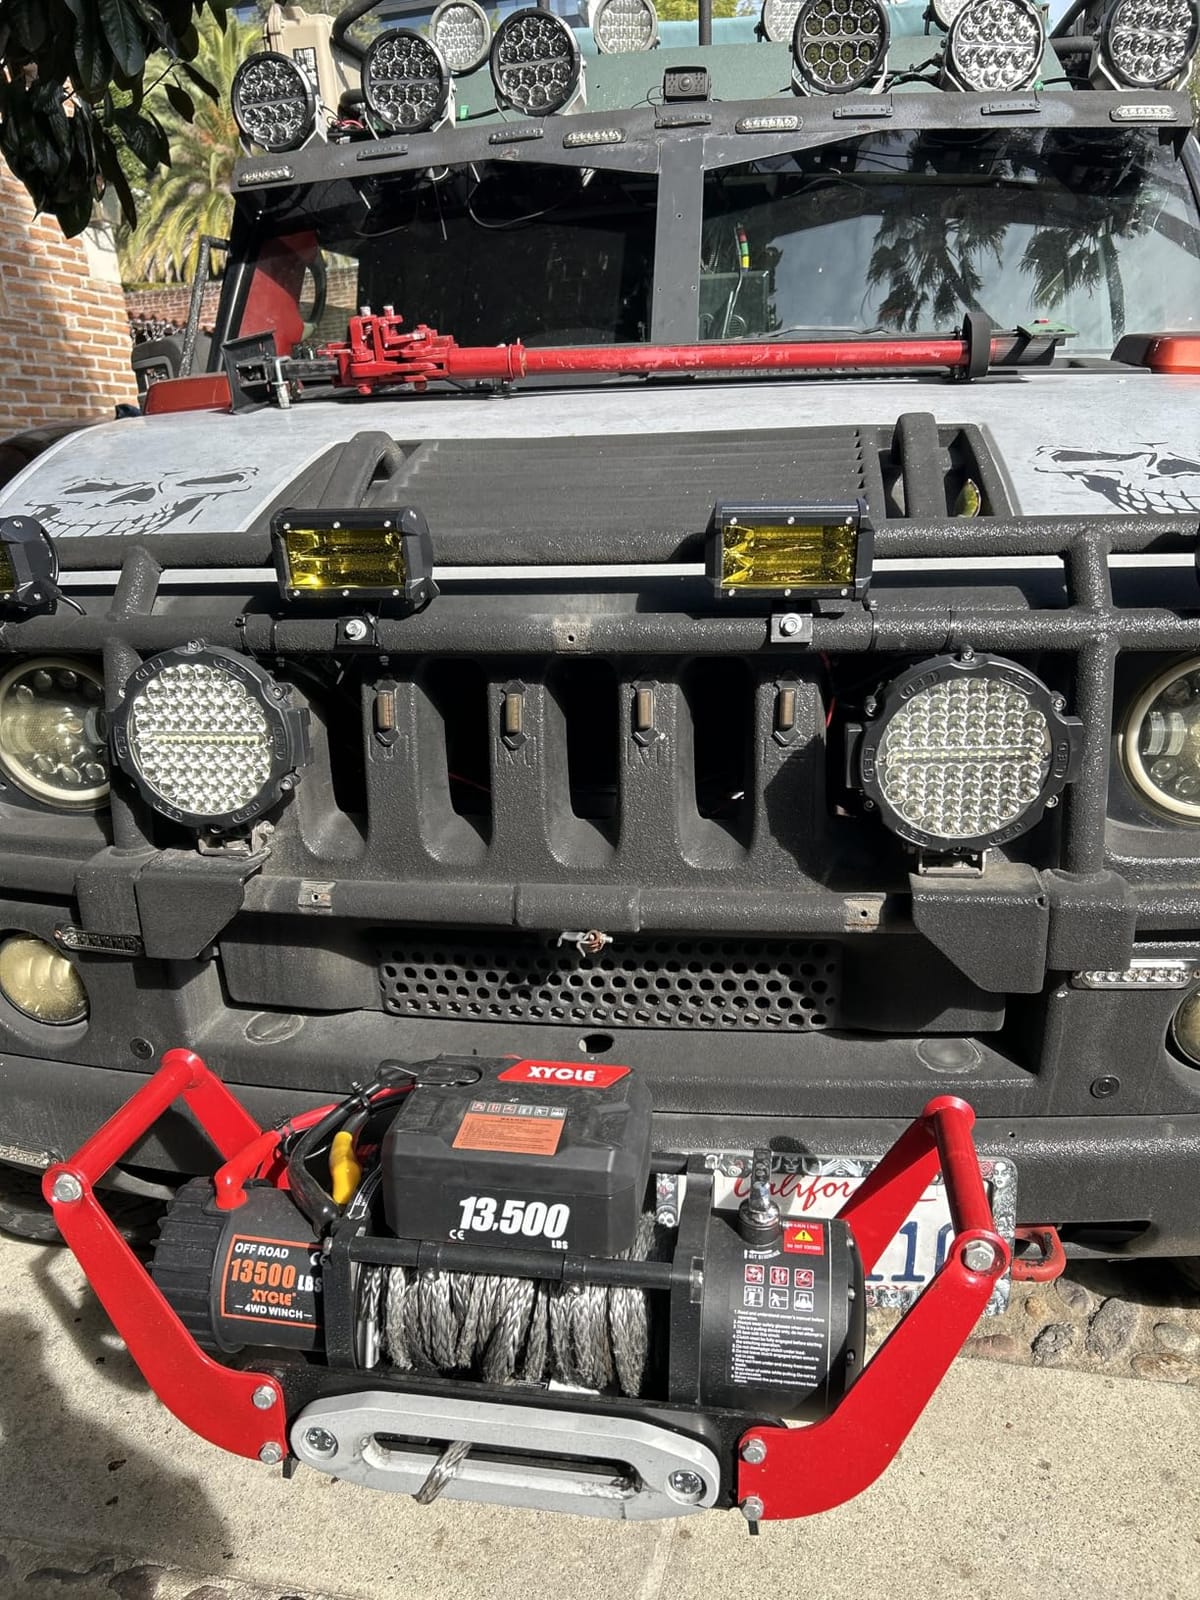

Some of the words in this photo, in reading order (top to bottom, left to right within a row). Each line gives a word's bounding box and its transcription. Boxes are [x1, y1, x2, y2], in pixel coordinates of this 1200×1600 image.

[527, 1066, 596, 1082] XYCLE
[235, 1242, 257, 1254] OFF
[257, 1246, 289, 1259] ROAD
[551, 1240, 568, 1250] LBS
[231, 1258, 296, 1289] 13500
[297, 1274, 322, 1293] LBS
[251, 1289, 293, 1306] XYCLE
[244, 1303, 267, 1314] 4WD
[268, 1306, 303, 1319] WINCH
